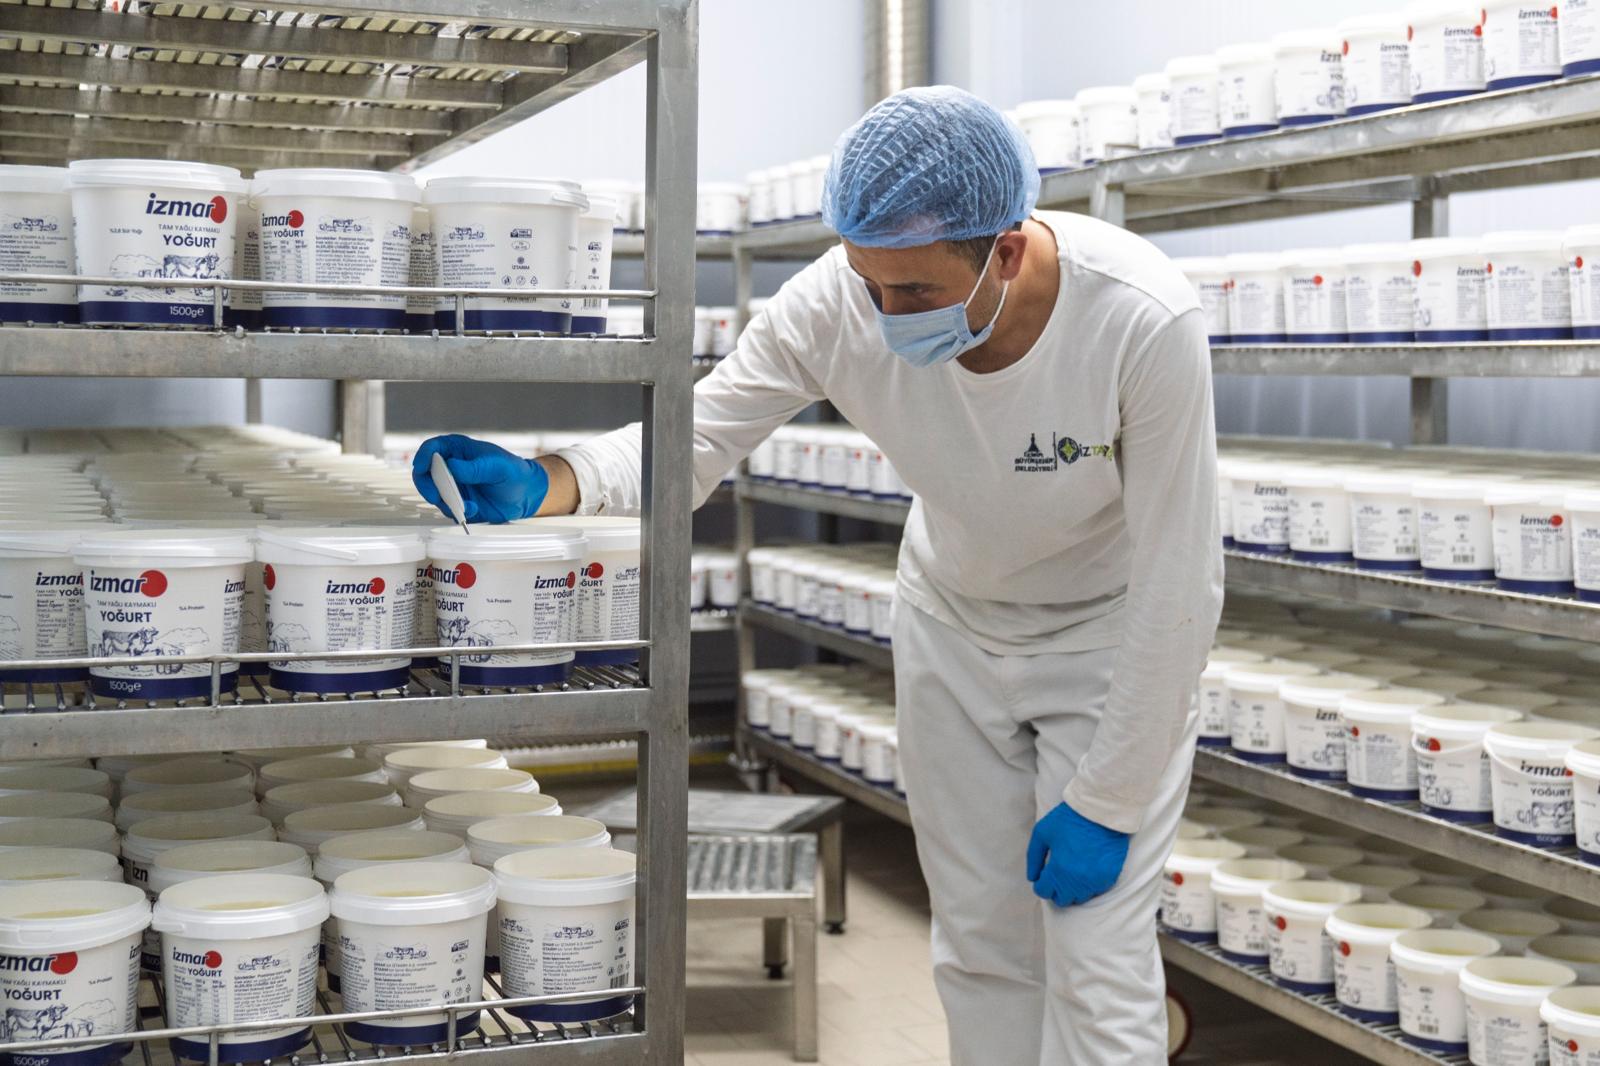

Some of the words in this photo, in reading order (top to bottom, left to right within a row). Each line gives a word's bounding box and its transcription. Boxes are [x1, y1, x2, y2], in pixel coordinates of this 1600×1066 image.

[145, 192, 216, 218] izmar
[262, 212, 291, 227] izmar
[273, 228, 305, 238] YOĞURT
[163, 233, 217, 248] YOĞURT
[90, 570, 147, 593] izmar
[326, 580, 375, 594] izmar
[580, 579, 603, 587] ĞURT
[349, 596, 385, 605] YOĞURT
[100, 609, 152, 623] YOĞURT
[173, 947, 208, 965] izmar
[187, 967, 222, 977] YOĞURT
[4, 988, 62, 1001] YOĞURT
